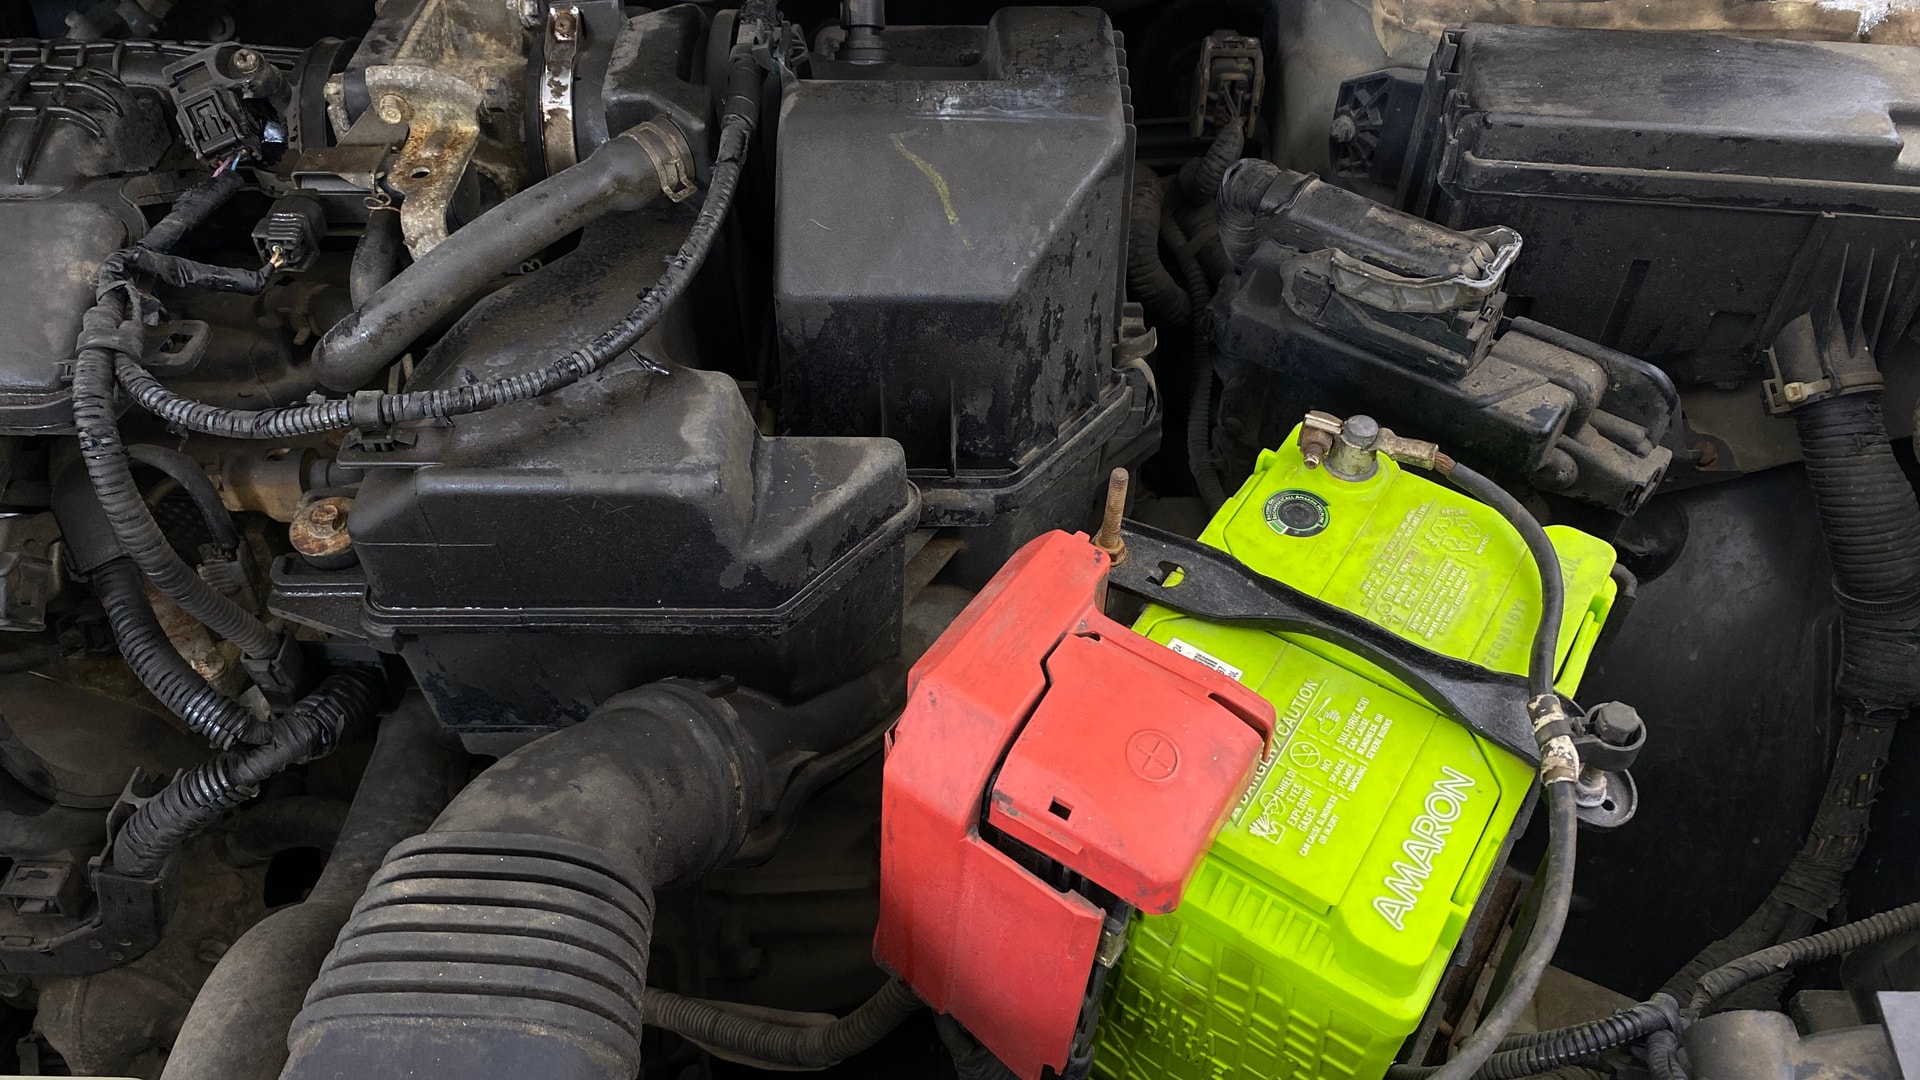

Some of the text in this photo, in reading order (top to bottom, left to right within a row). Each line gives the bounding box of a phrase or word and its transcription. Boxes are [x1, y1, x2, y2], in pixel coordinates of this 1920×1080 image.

[1276, 678, 1318, 736] CAUTION
[1336, 697, 1369, 745] SULFURIC ACID
[1347, 718, 1370, 750] CAN CAUSE
[1356, 713, 1383, 755] BLINDNESS OR
[1366, 718, 1393, 759] SEVERE BURNS
[1320, 759, 1332, 772] NO
[1328, 759, 1347, 783] SPARKS
[1338, 764, 1356, 788] FLAMES
[1347, 766, 1367, 792] SMOKING
[1275, 769, 1297, 796] SHIELD
[1286, 783, 1303, 803] EYES
[1287, 787, 1315, 827] EXPLOSIVE
[1297, 807, 1317, 832] GASES
[1299, 795, 1338, 856] CAN CAUSE BLINDNESS
[1319, 814, 1339, 844] OR INJURY
[1372, 765, 1476, 932] AMARON
